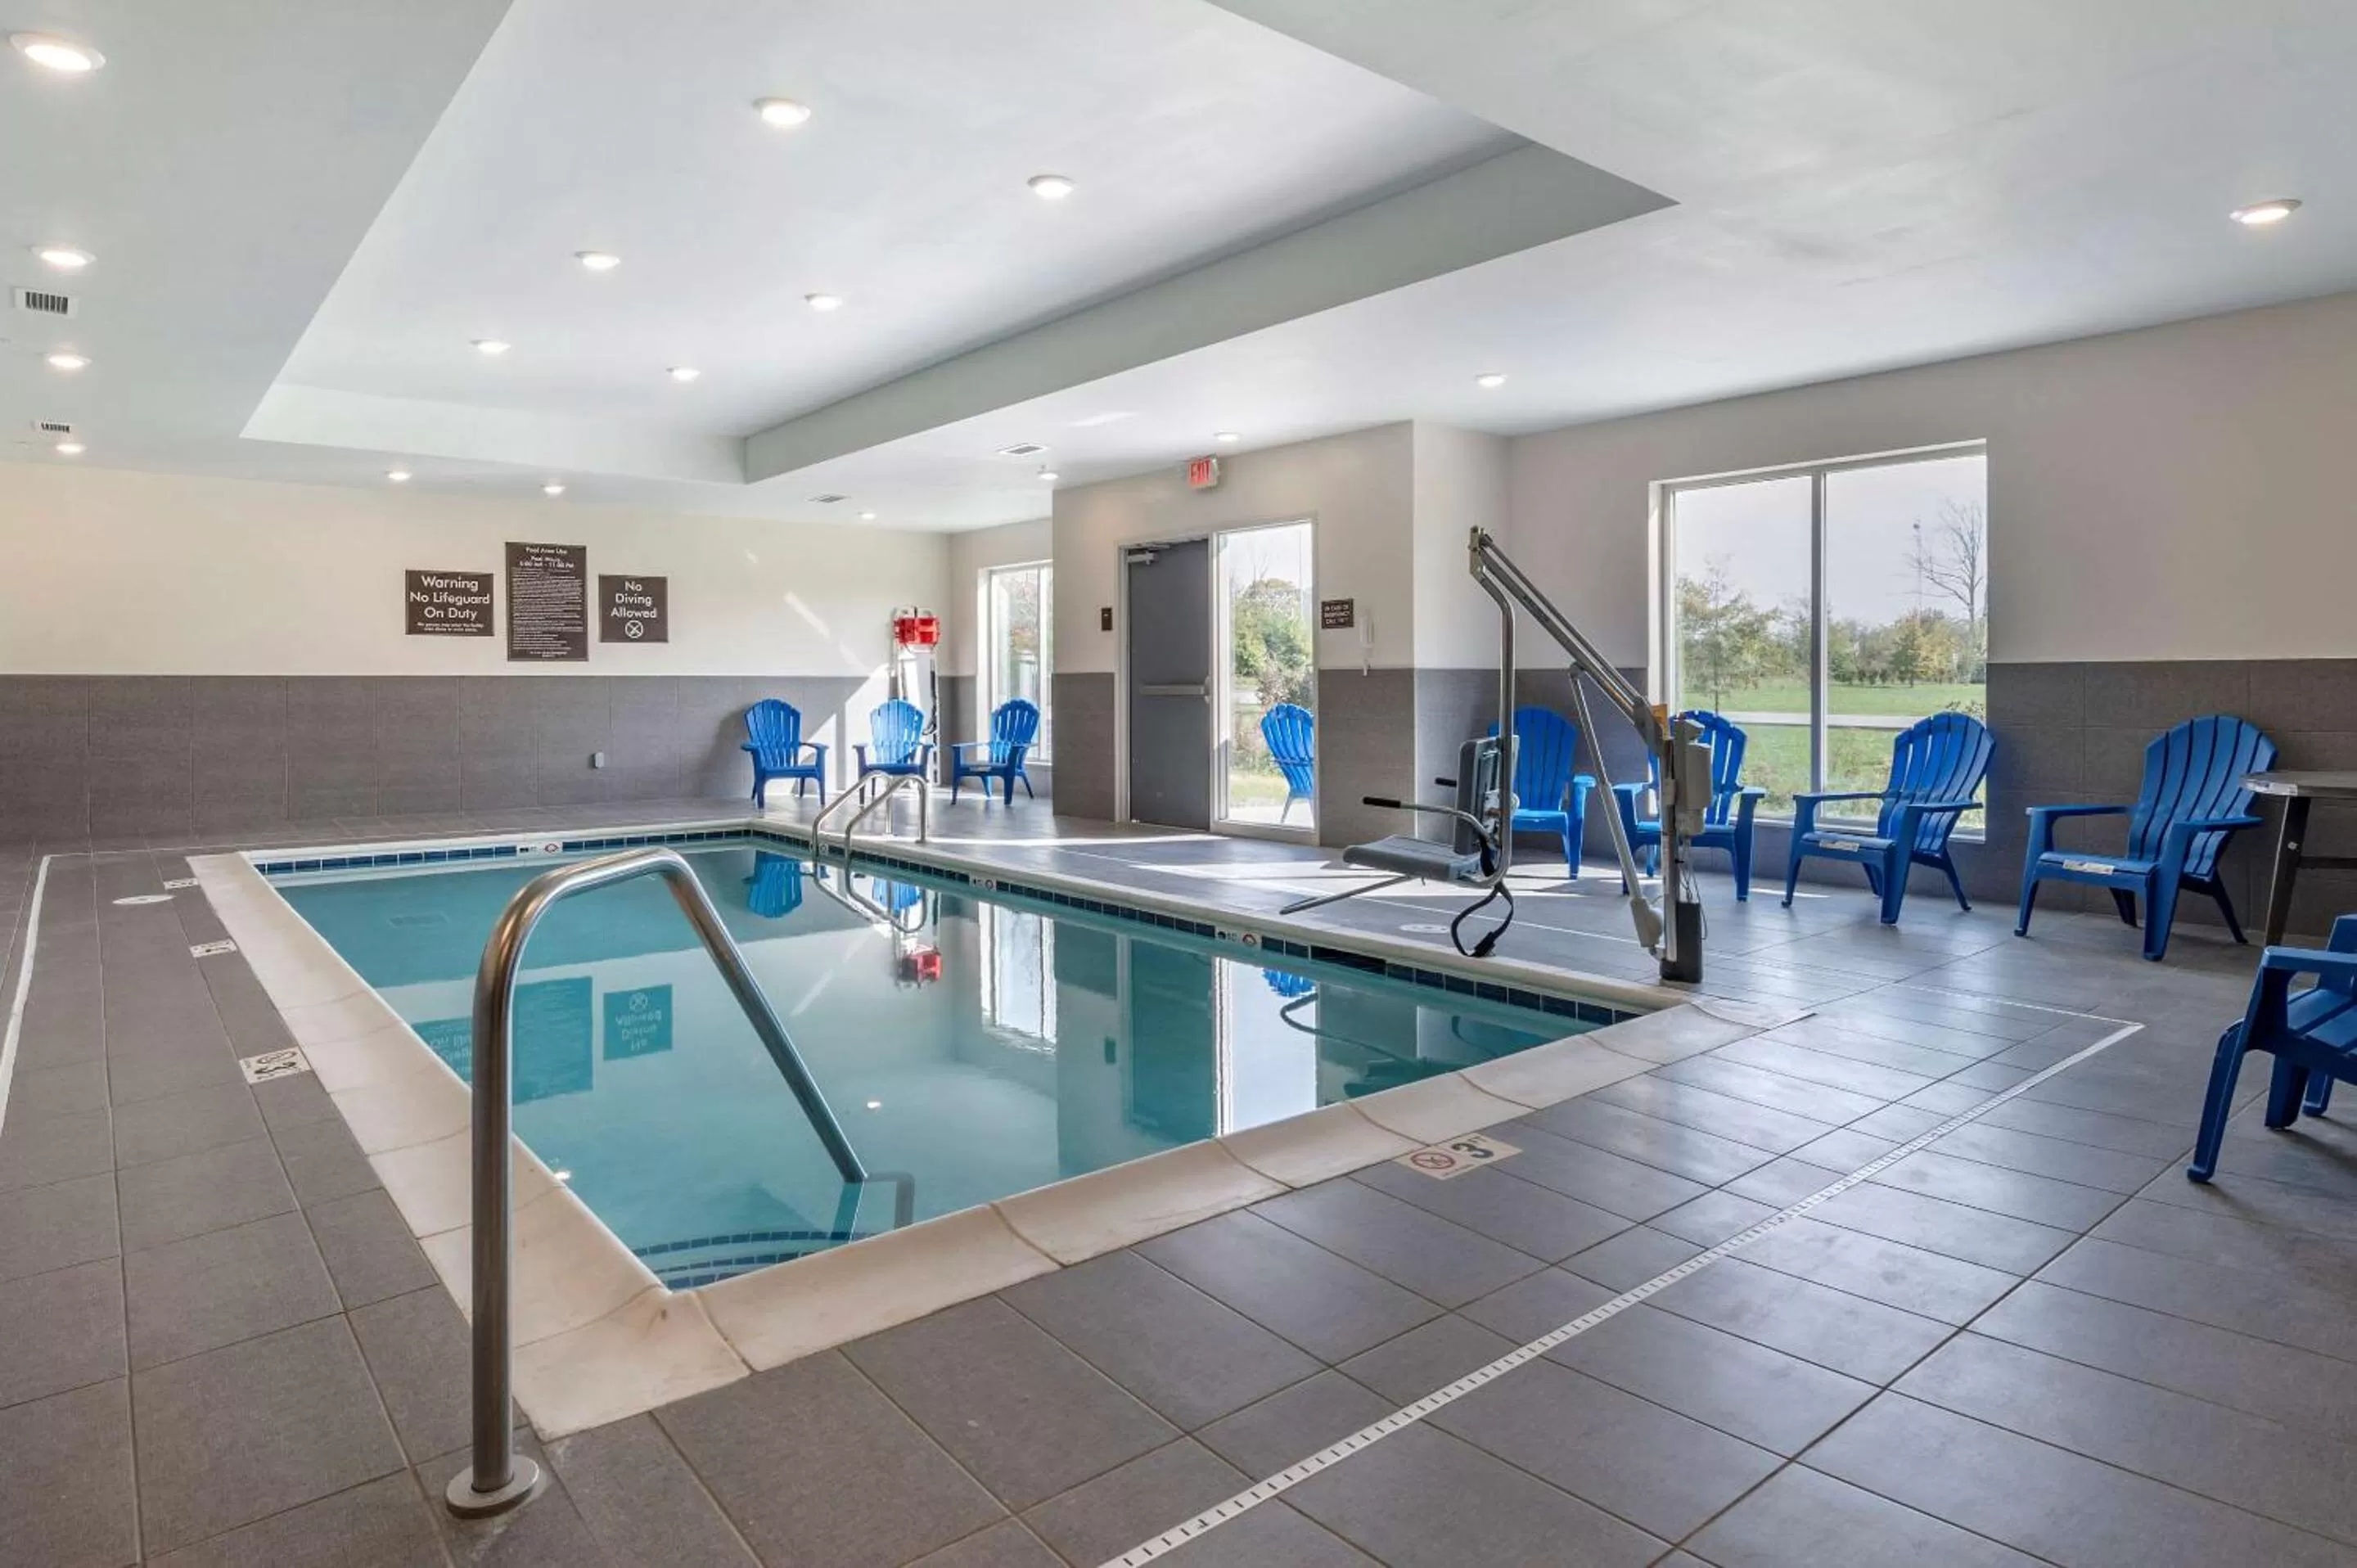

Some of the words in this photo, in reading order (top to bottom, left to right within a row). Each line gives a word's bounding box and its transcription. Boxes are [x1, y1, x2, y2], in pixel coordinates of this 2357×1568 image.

[1190, 461, 1210, 480] EXIT
[421, 575, 479, 593] Warning
[624, 580, 642, 592] No
[410, 591, 429, 602] No
[433, 592, 490, 606] Lifeguard
[615, 593, 652, 606] Diving
[424, 606, 444, 618] On
[448, 607, 478, 621] Duty
[611, 606, 658, 619] Allowed
